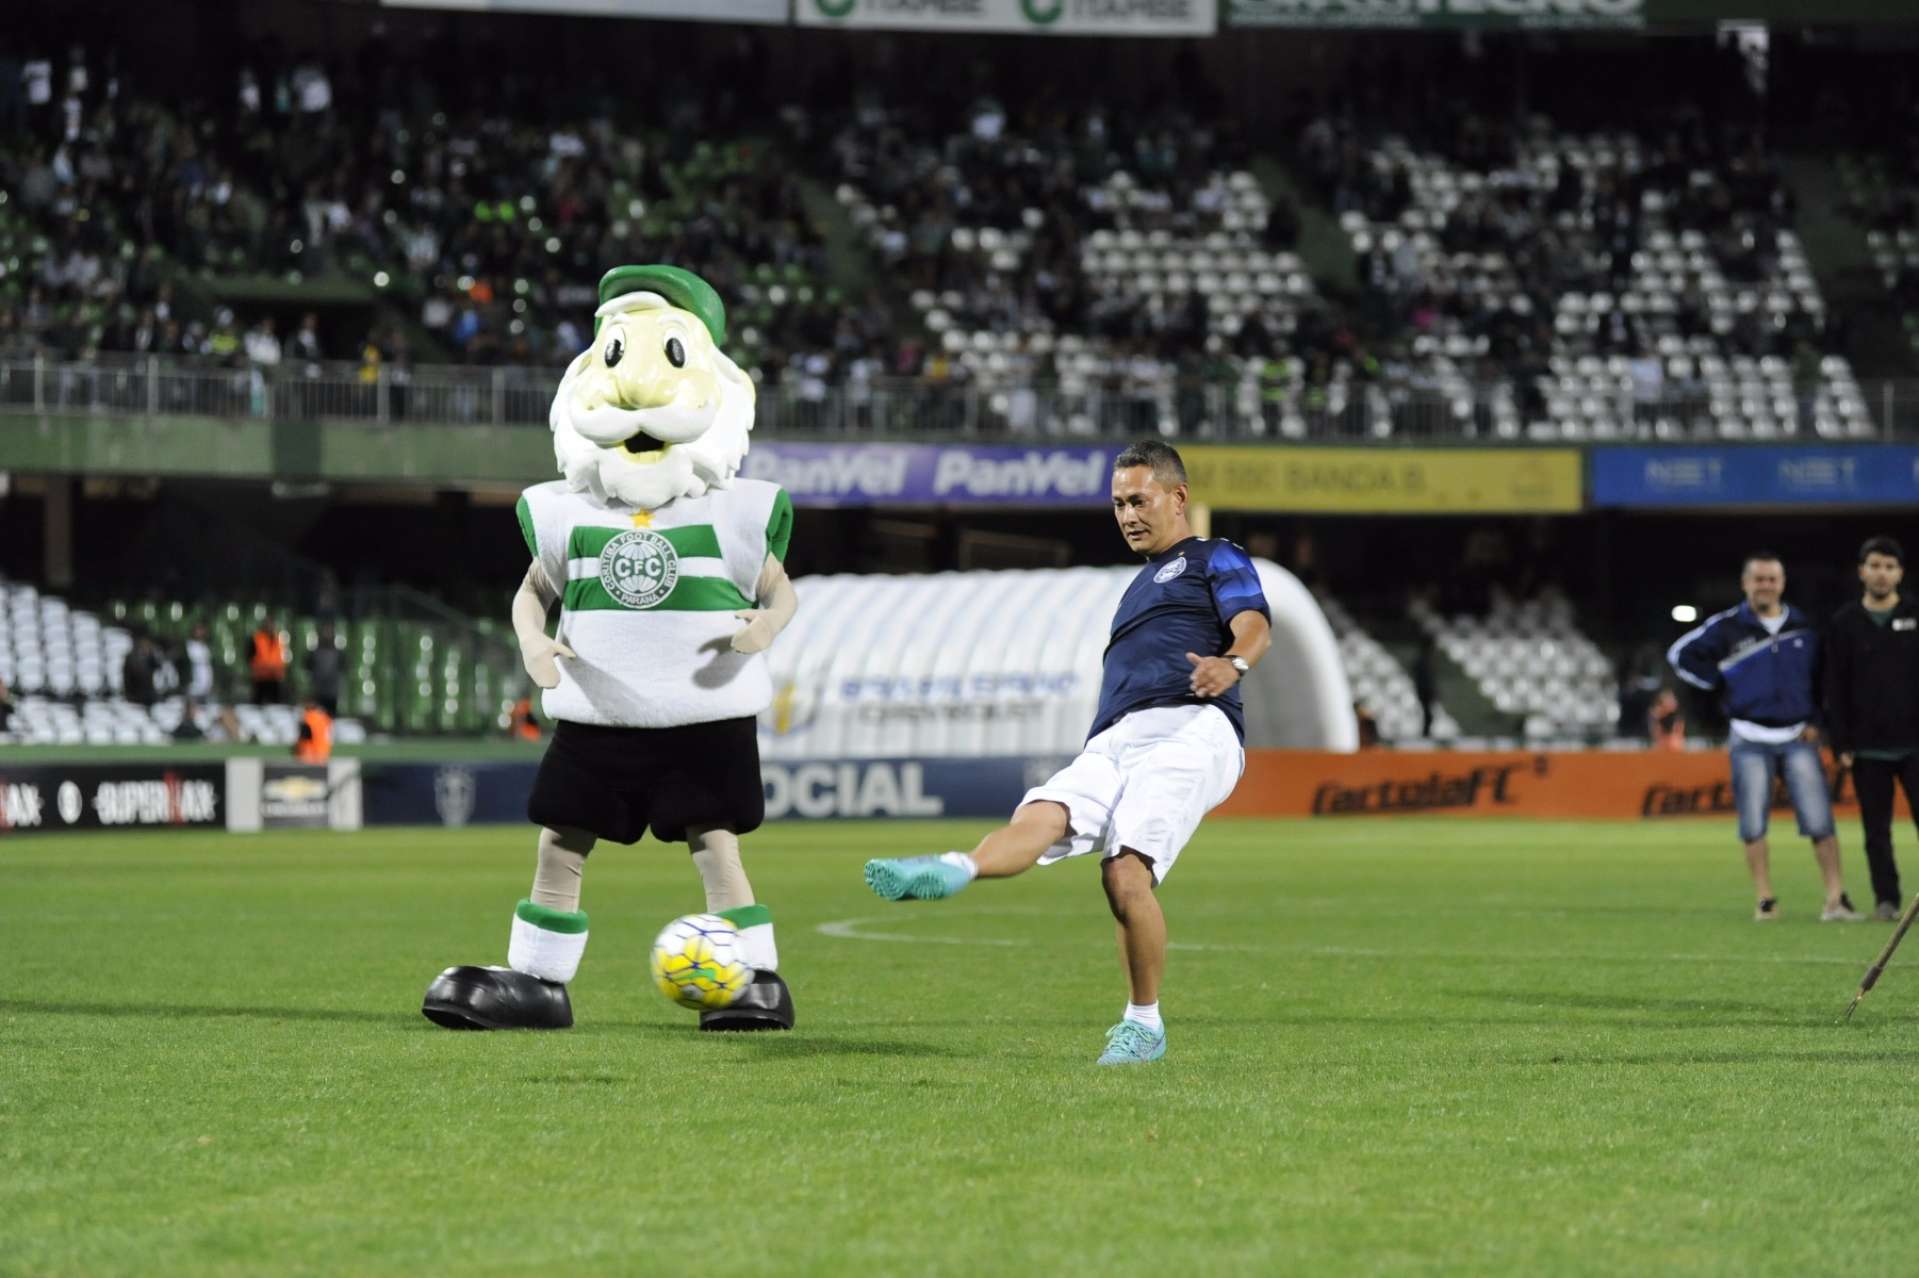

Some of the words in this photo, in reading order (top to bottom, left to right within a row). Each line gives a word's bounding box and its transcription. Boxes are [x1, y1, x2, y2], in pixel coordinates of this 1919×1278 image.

[746, 452, 908, 495] PanVel
[933, 451, 1106, 496] PanVel
[614, 557, 661, 577] CFC
[760, 761, 944, 818] OCIAL
